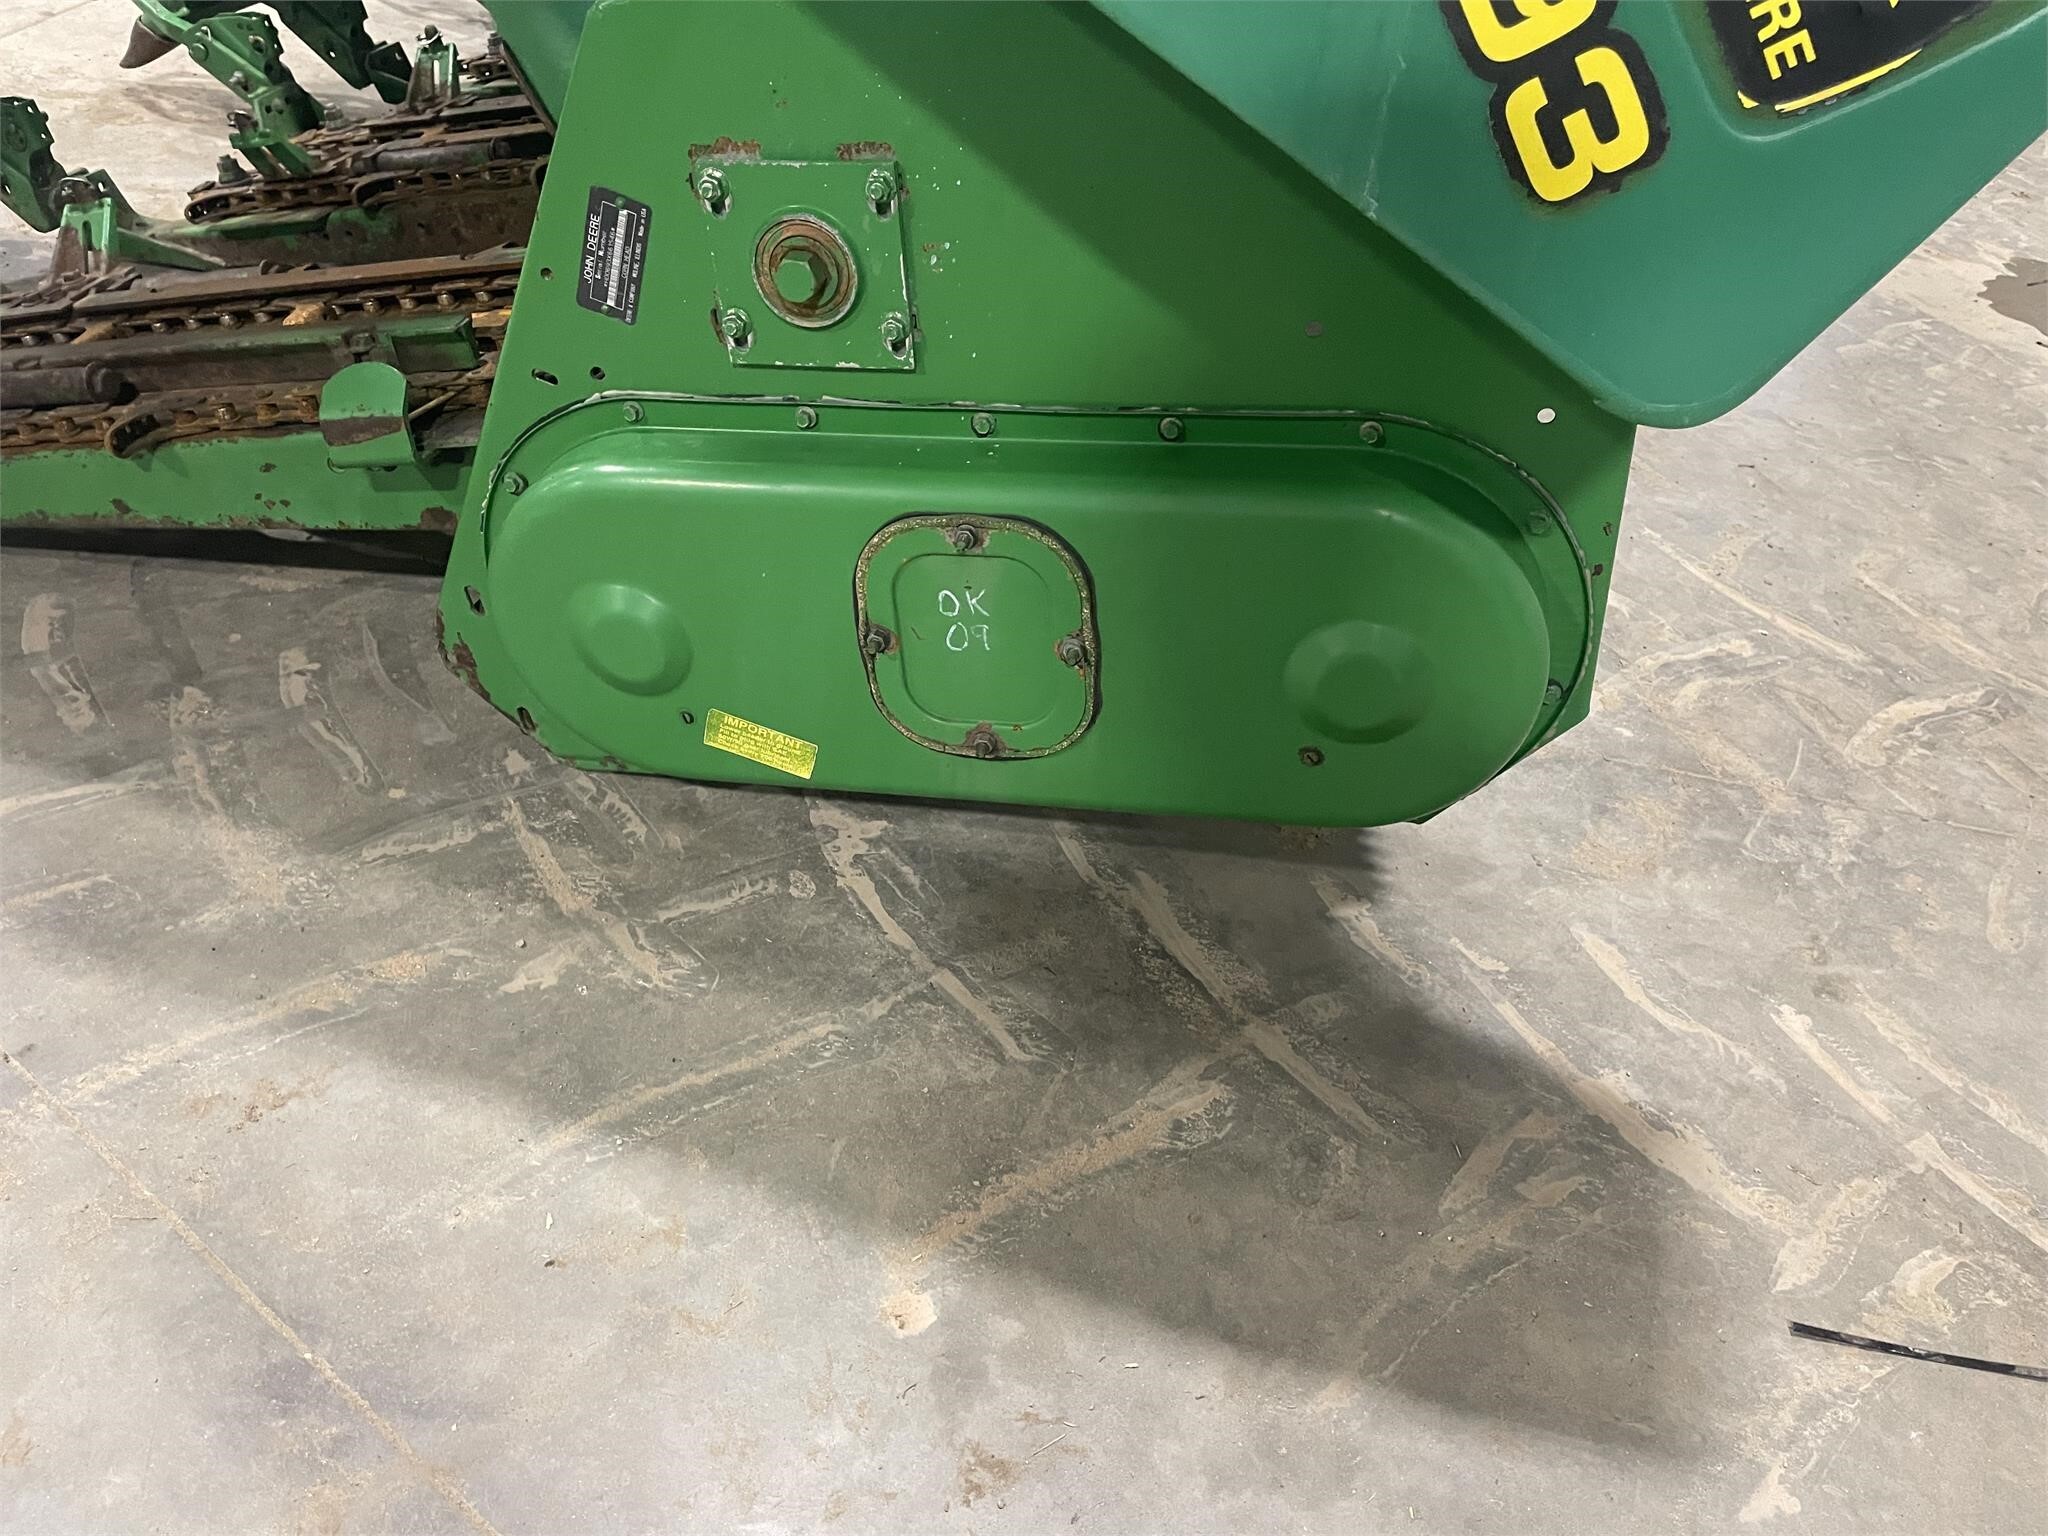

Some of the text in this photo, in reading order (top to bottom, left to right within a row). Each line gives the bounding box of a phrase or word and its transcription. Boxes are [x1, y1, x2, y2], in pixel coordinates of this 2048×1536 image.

[583, 213, 600, 284] JOHN DEERE
[723, 715, 803, 750] IMPORTANT
